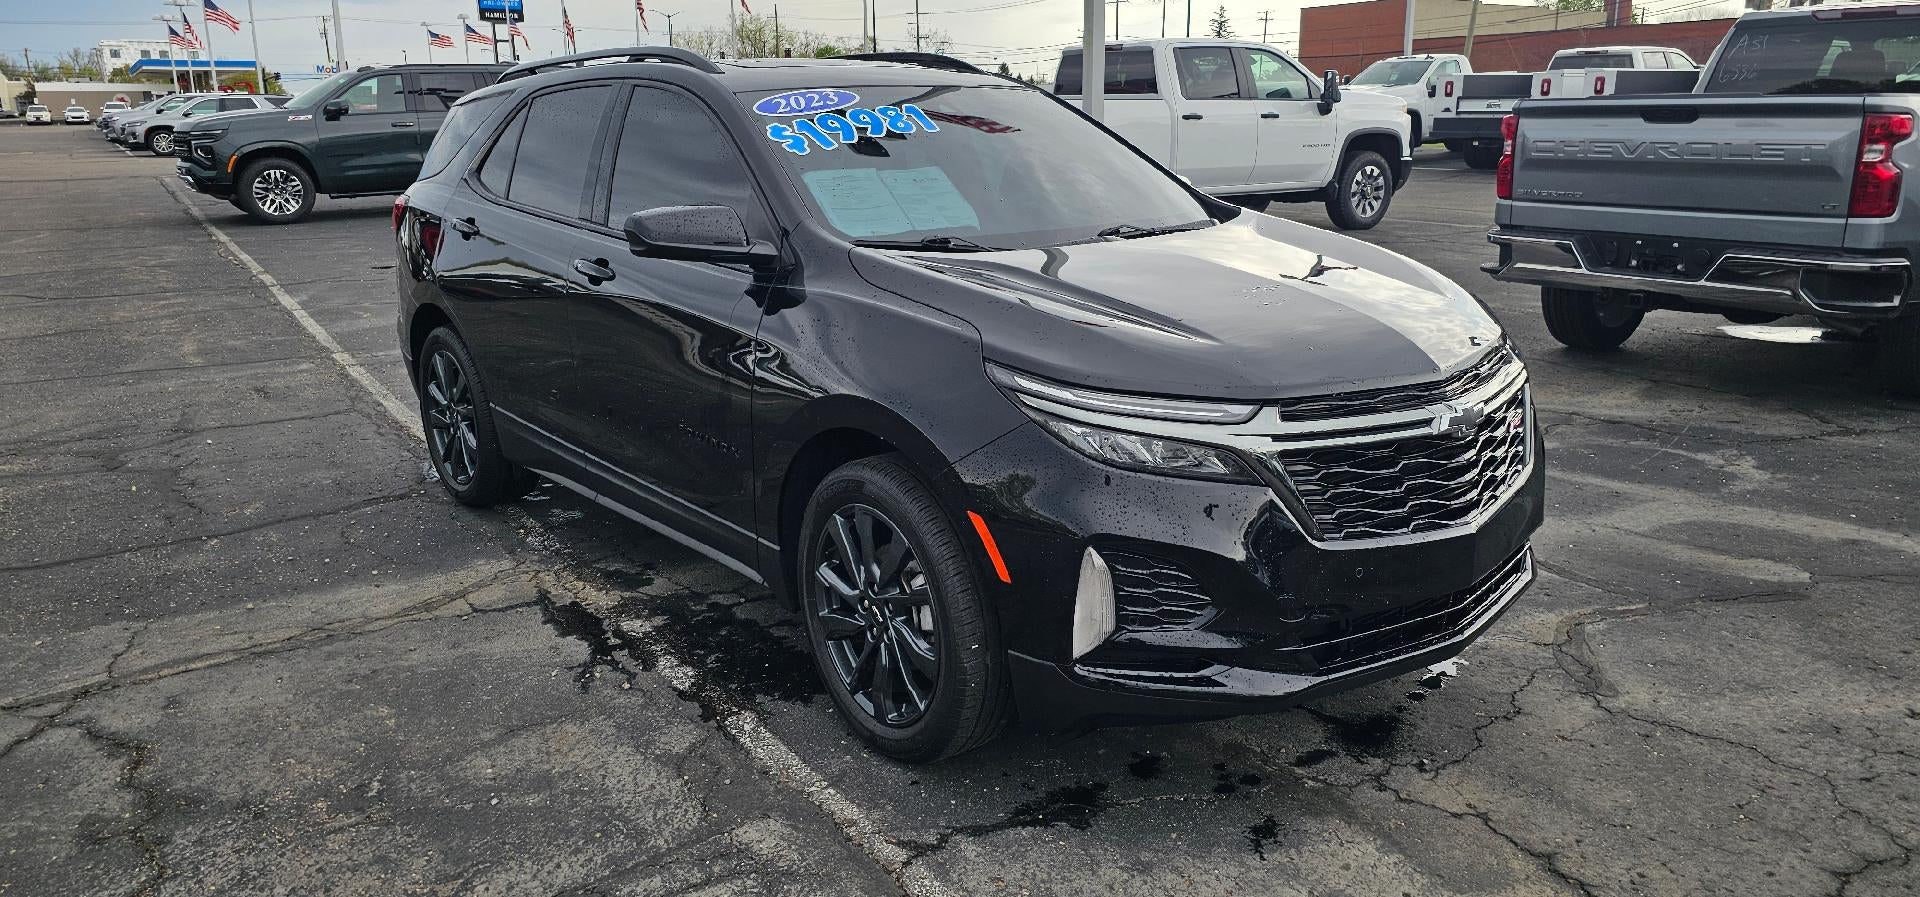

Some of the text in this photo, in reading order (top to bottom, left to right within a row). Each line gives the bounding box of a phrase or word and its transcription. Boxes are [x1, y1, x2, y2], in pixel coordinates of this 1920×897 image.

[485, 11, 519, 19] HAMILON
[316, 65, 337, 73] Mob
[772, 91, 839, 114] 2023
[766, 104, 940, 156] $19981
[1531, 140, 1826, 161] CHEVROLET
